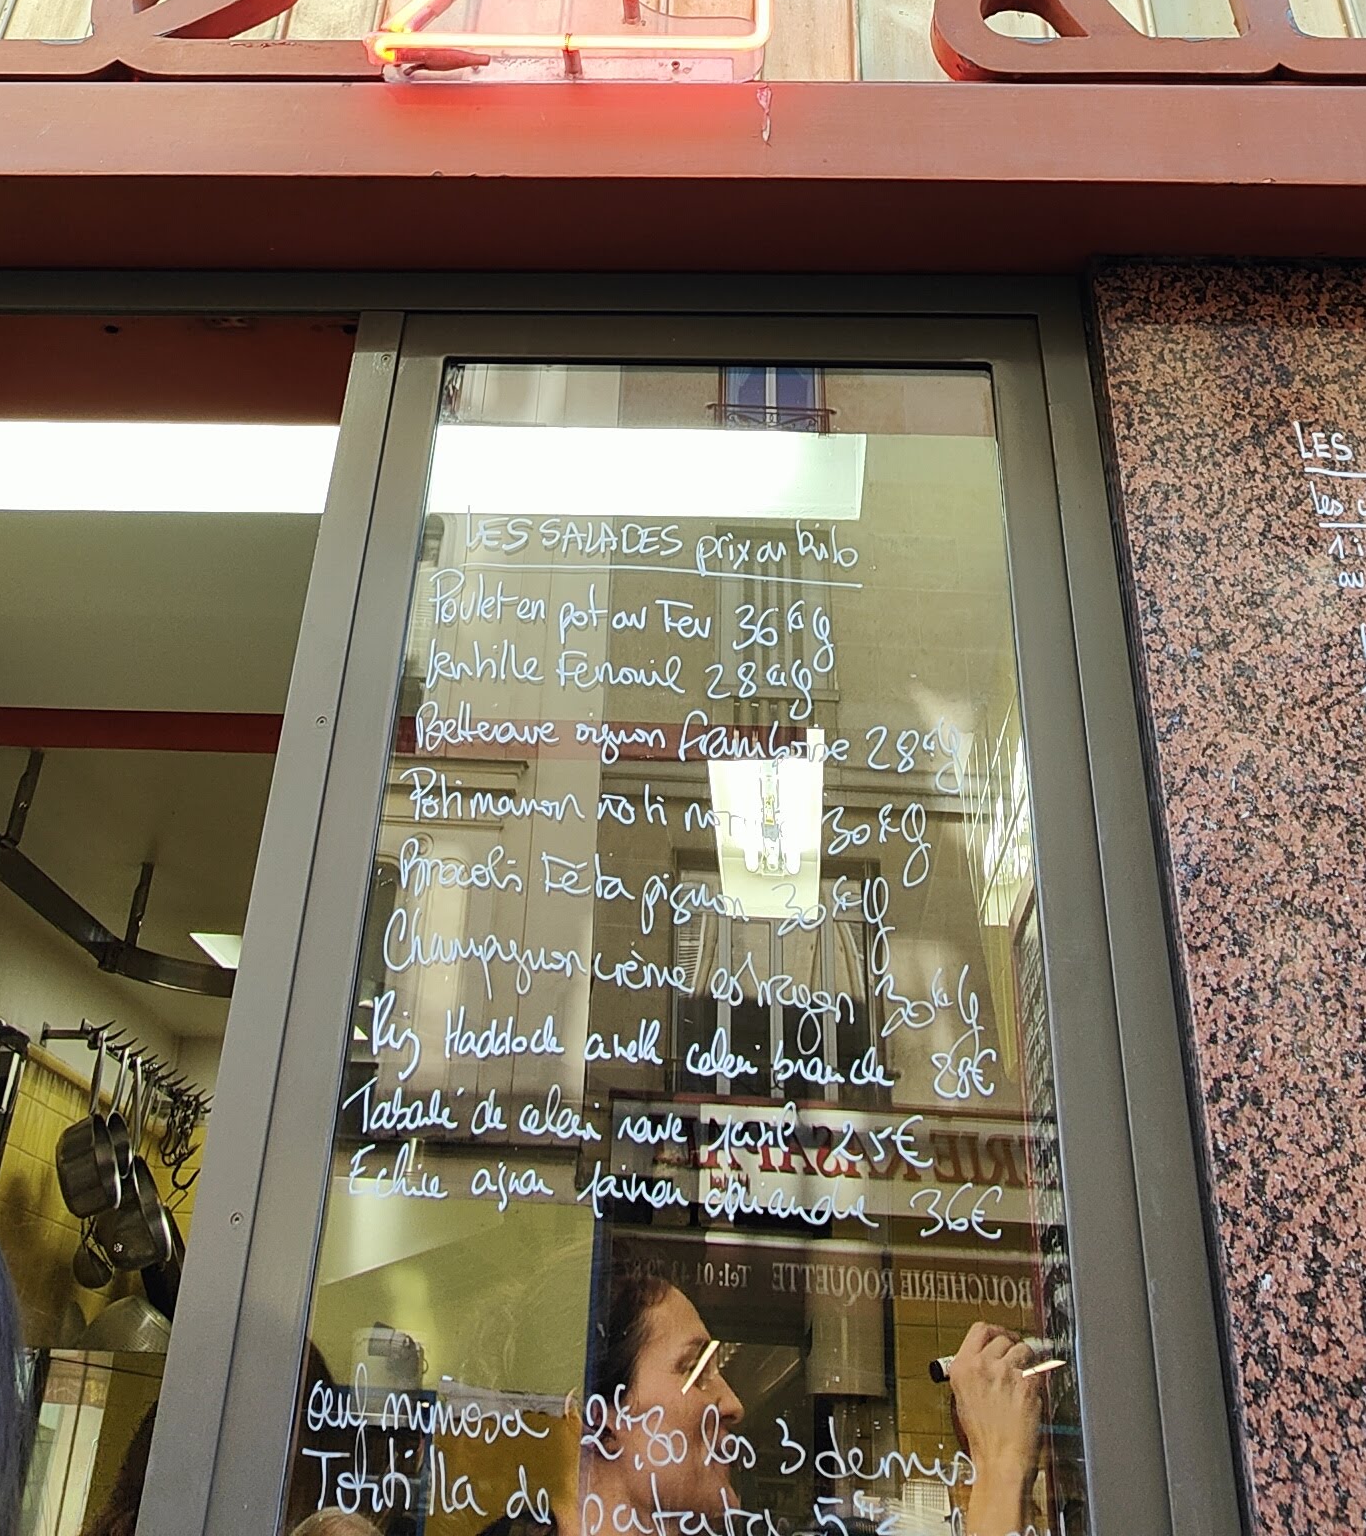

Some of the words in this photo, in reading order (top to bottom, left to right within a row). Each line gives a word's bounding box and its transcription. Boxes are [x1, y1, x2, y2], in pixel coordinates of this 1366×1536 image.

[1293, 421, 1354, 461] LES
[466, 505, 532, 551] LES
[540, 517, 682, 557] SALADES
[696, 533, 749, 576] prix
[757, 540, 786, 563] au
[796, 520, 858, 566] kilo
[429, 569, 515, 624] Poulet
[517, 593, 545, 622] en
[559, 583, 608, 644] pot
[612, 605, 646, 631] au
[1336, 571, 1364, 589] au
[415, 701, 559, 751] Betterave
[575, 720, 666, 764] oignon
[641, 874, 749, 934] pignon
[383, 907, 588, 1001] Champignon
[594, 950, 696, 989] crème
[711, 952, 855, 1054] estragon
[372, 990, 420, 1081] Riz
[445, 1005, 565, 1059] Haddock
[774, 1040, 894, 1087] branche
[471, 1088, 508, 1135] de
[617, 1102, 688, 1145] rave
[709, 1100, 797, 1163] persil
[833, 1114, 934, 1169] 25€
[909, 1181, 1003, 1240] 36€
[381, 1375, 549, 1445] mimosa
[703, 1404, 757, 1471] les
[776, 1418, 806, 1474] 3
[814, 1415, 977, 1488] demis
[302, 1437, 487, 1518] Tortilla
[506, 1463, 551, 1526] de
